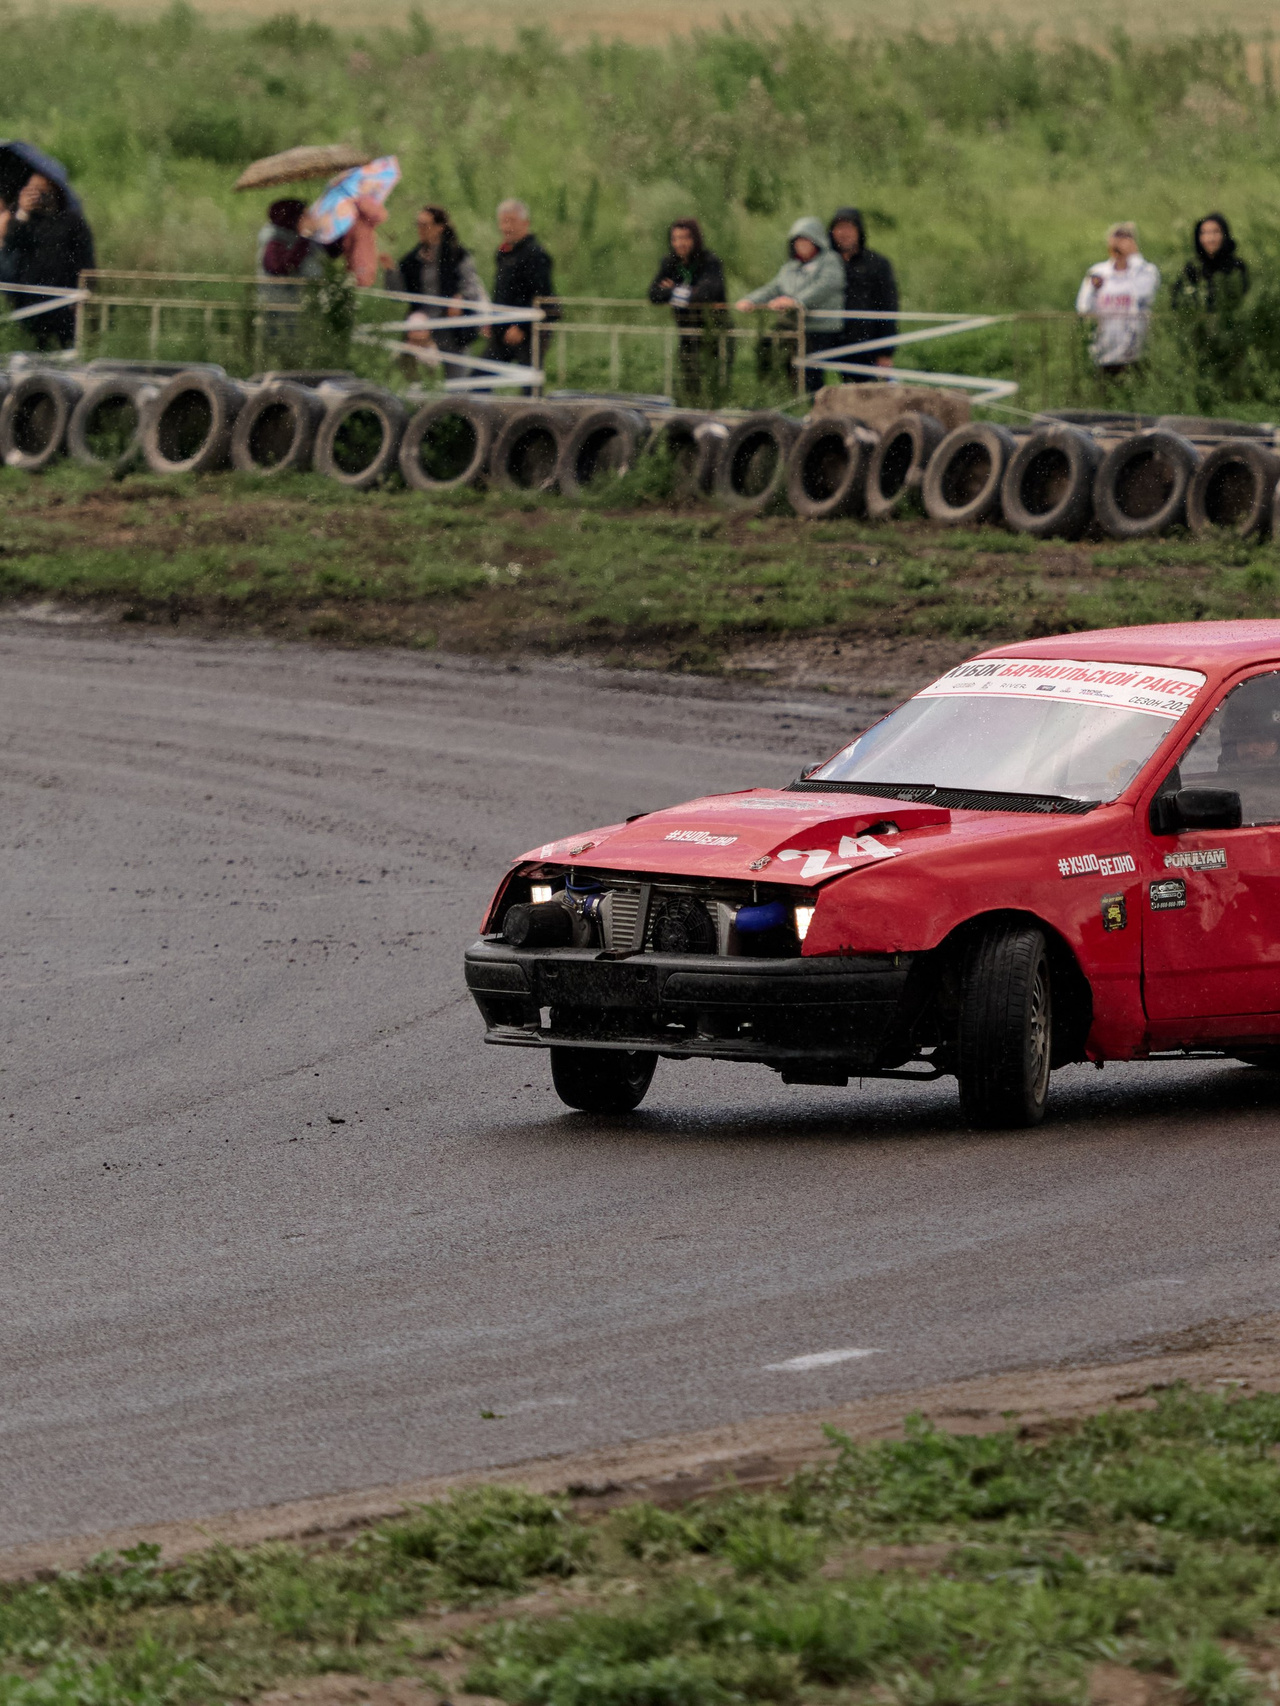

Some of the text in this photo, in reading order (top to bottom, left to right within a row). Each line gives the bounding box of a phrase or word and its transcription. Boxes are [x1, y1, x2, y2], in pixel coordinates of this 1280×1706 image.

[945, 664, 1006, 679] КУБОК
[997, 664, 1142, 687] БАРНАУЛЬСКОЙ
[1128, 696, 1164, 707] СЕЗОН
[777, 835, 903, 879] 24
